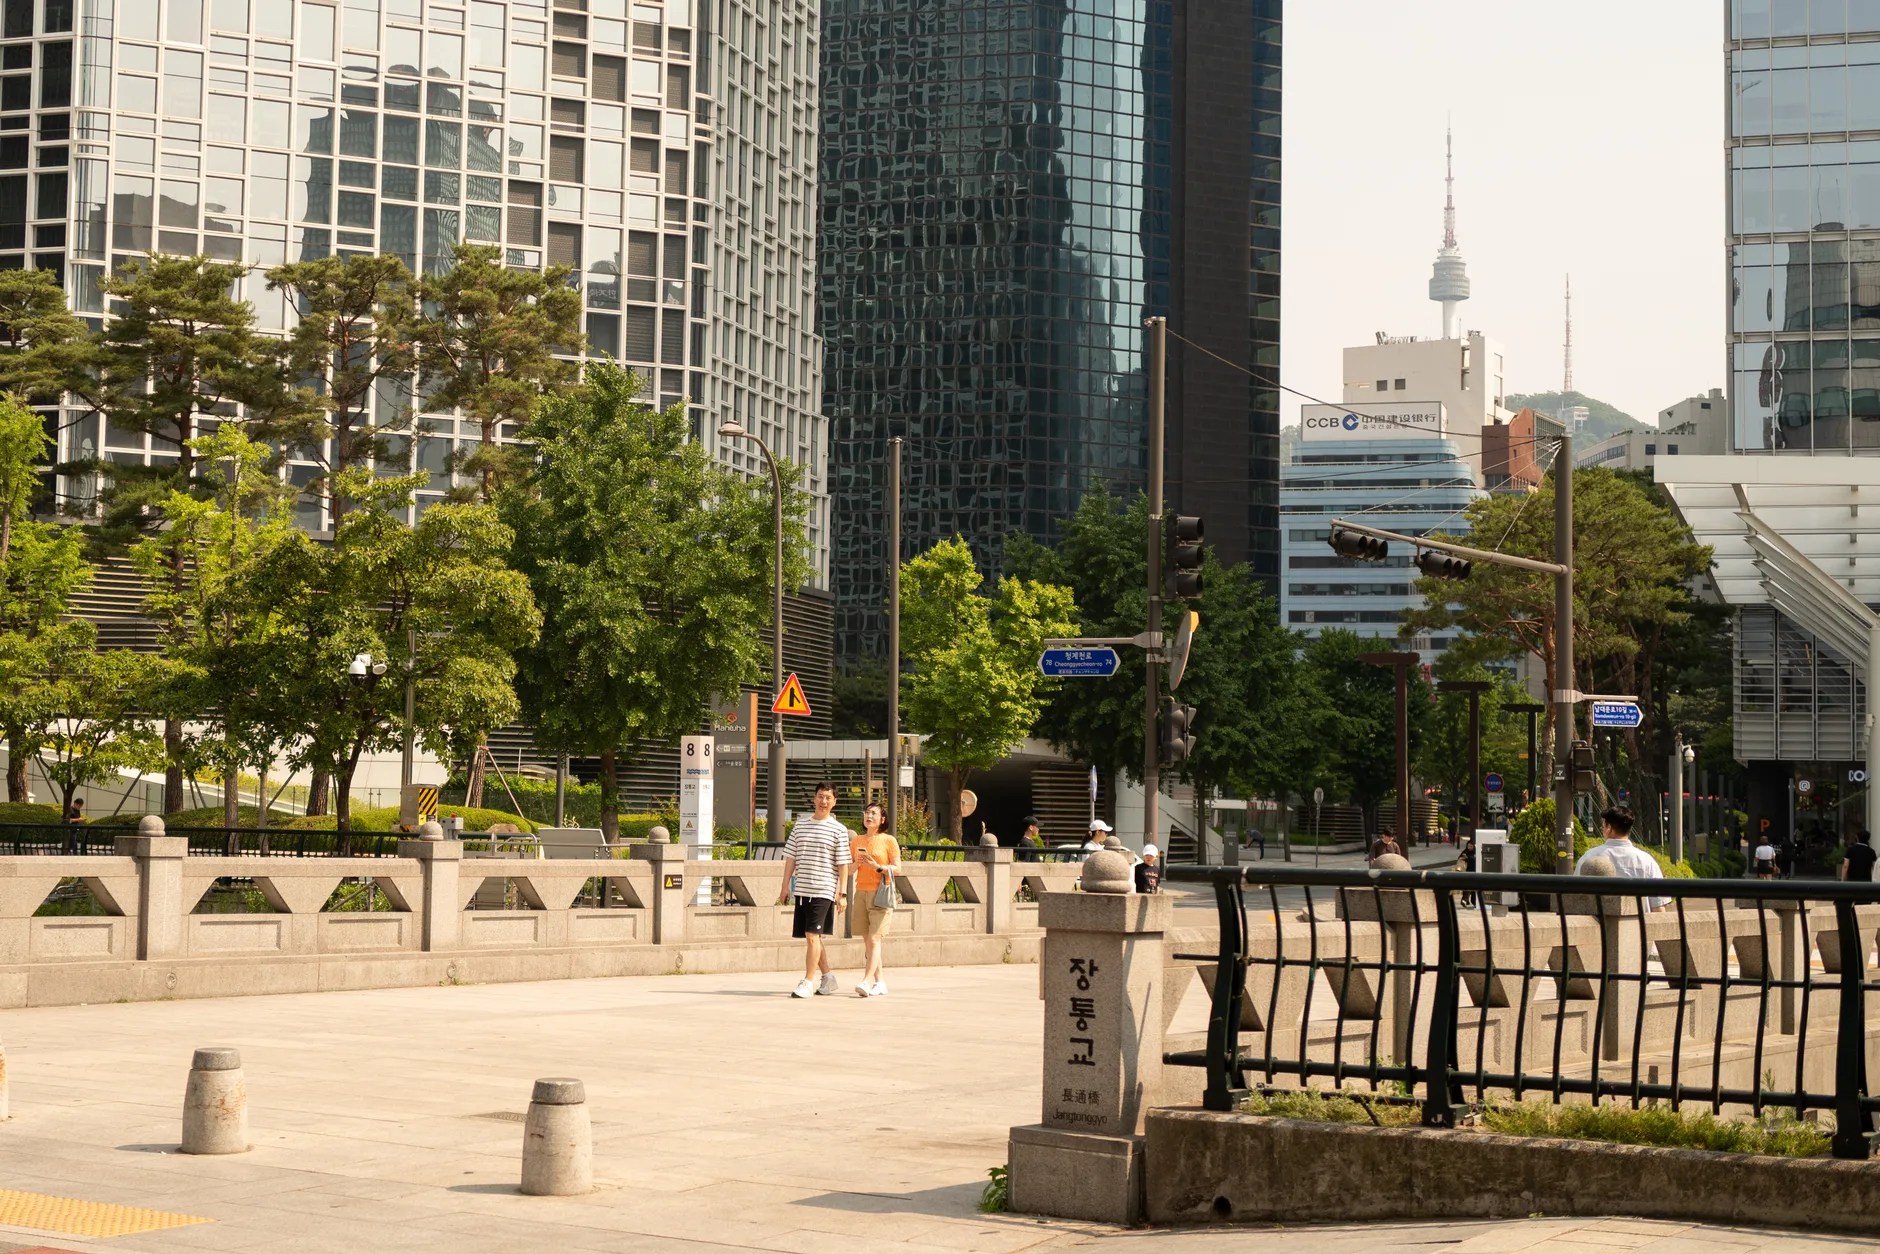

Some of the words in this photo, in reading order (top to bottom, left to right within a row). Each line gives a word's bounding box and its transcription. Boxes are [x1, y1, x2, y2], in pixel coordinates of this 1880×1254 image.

[1306, 417, 1339, 428] CCB
[1361, 413, 1437, 424] 中国建设银行
[1065, 651, 1092, 661] 청계천로
[1105, 658, 1112, 666] 74
[714, 724, 747, 732] Hanwha
[686, 742, 695, 757] 8
[704, 743, 710, 757] 8
[1848, 769, 1866, 782] CO
[1760, 818, 1771, 832] P
[1067, 958, 1099, 1067] 장통교
[1061, 1088, 1100, 1106] 長通橋
[1052, 1108, 1108, 1126] Jangtonggyo
